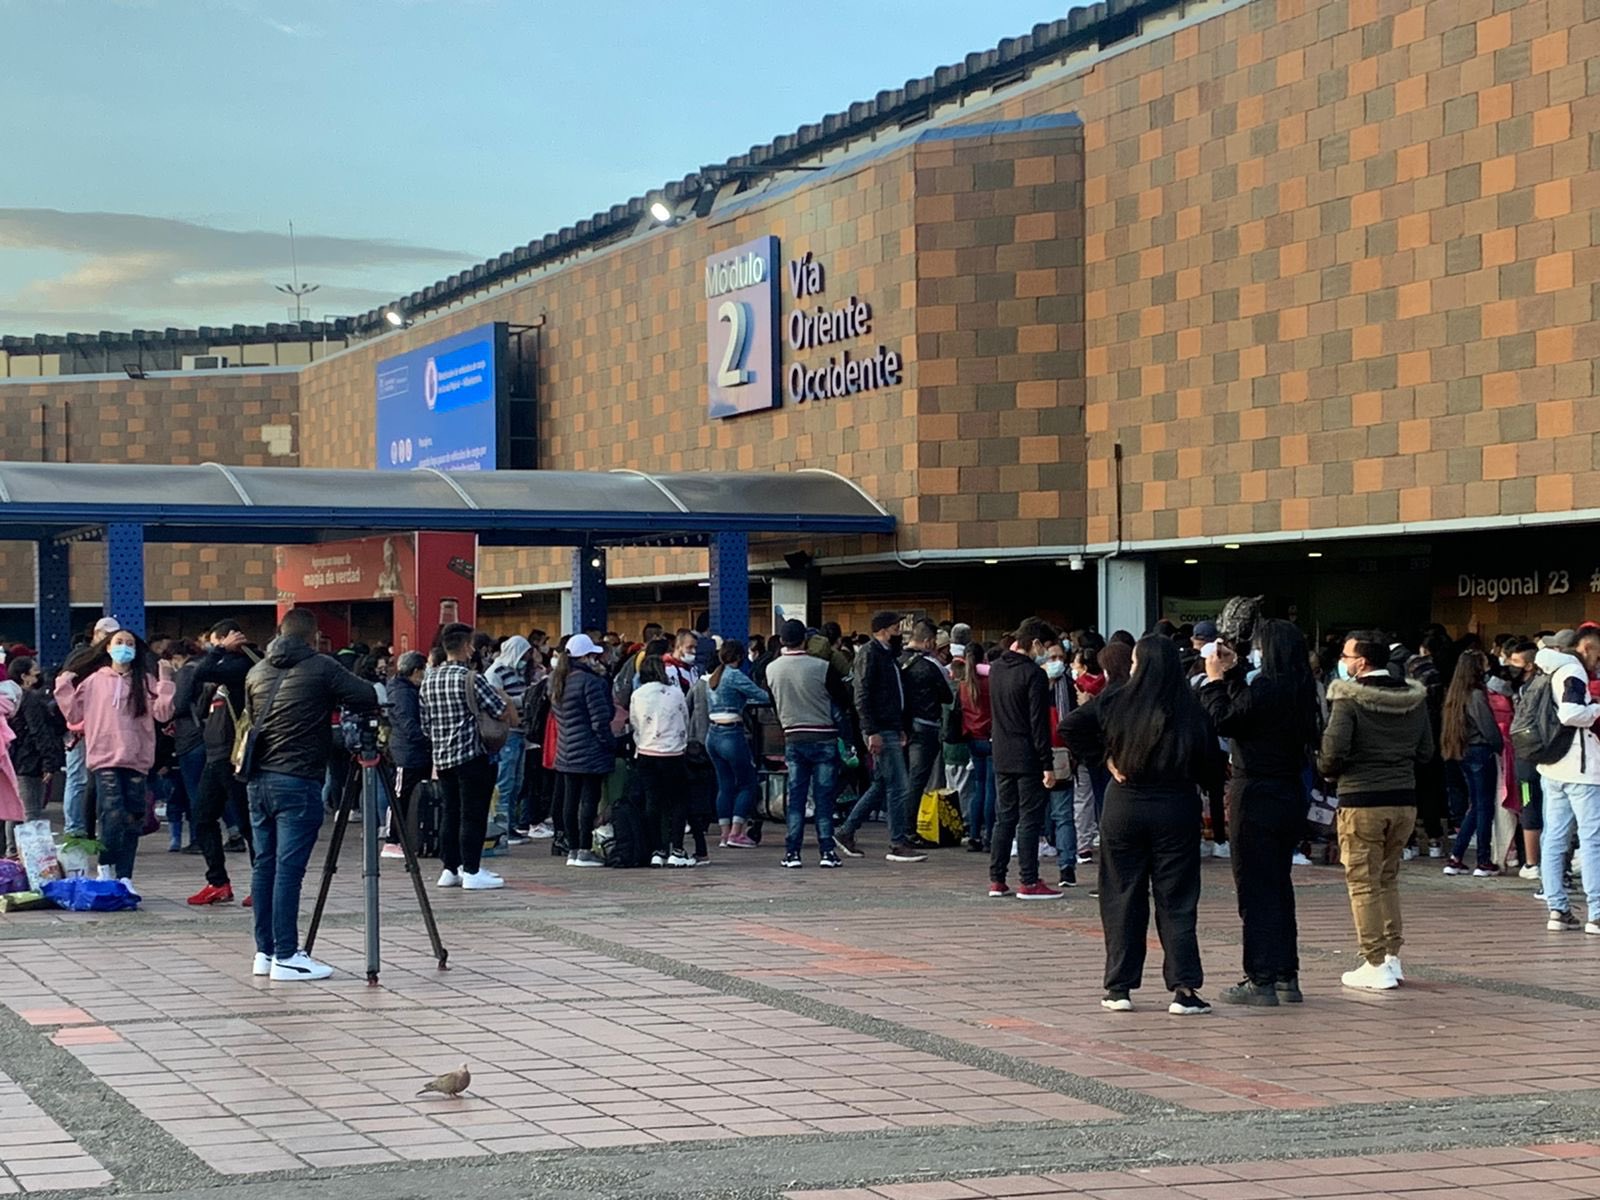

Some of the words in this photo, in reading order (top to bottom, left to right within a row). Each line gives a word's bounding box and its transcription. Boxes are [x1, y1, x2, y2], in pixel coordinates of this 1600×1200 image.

[705, 251, 764, 298] Módulo
[789, 251, 823, 298] Vía
[717, 300, 748, 387] 2
[788, 296, 870, 349] Oriente
[788, 345, 902, 403] Occidente
[1457, 570, 1539, 602] Diagonal
[1547, 570, 1570, 595] 23
[1179, 613, 1218, 622] COVID-1
